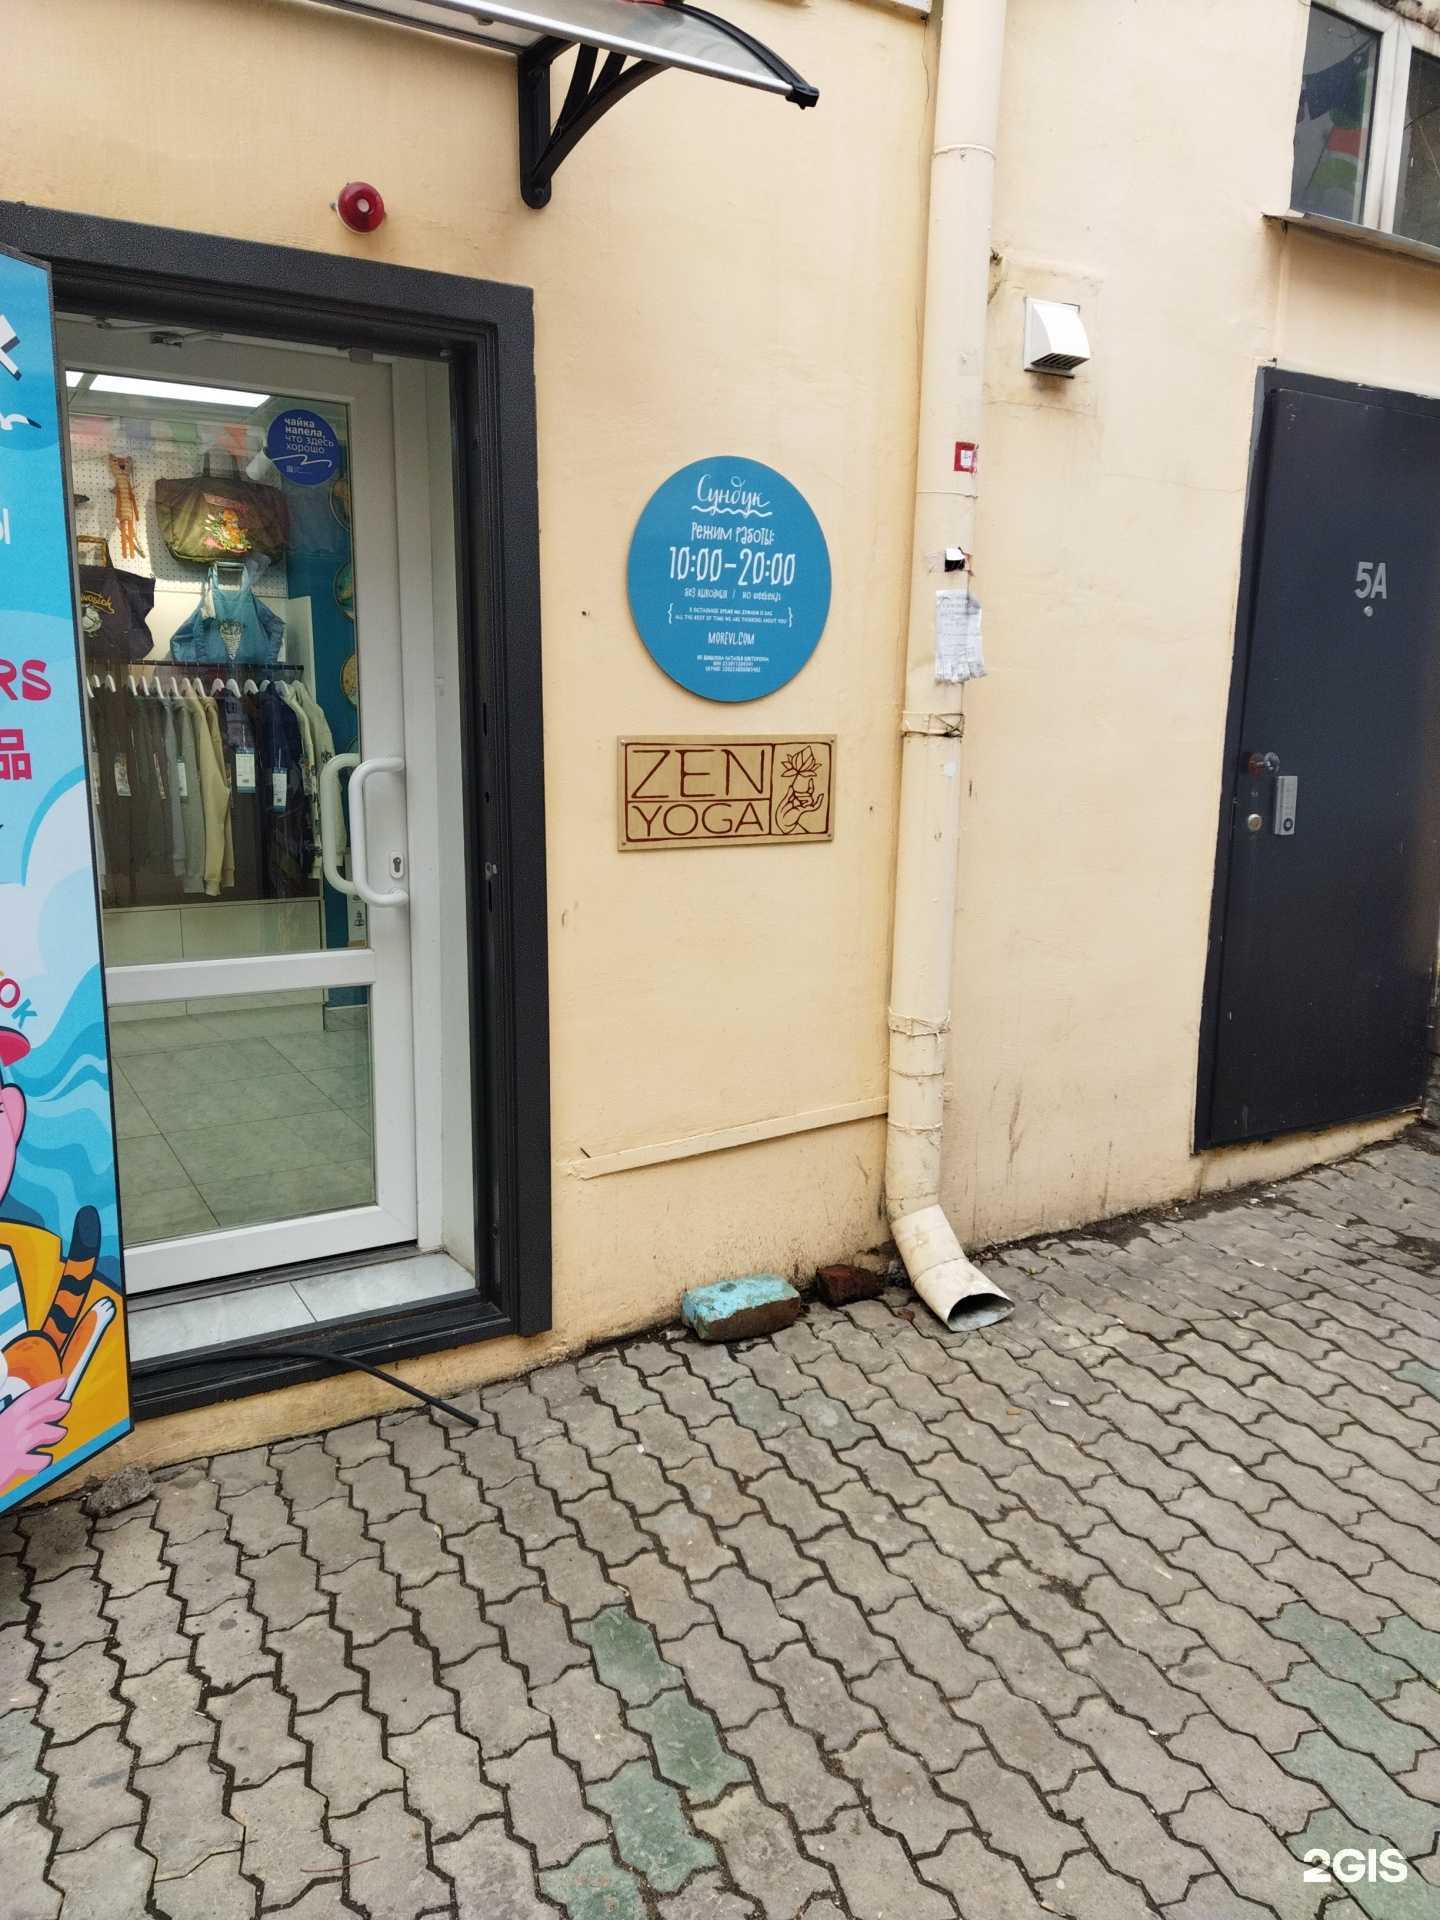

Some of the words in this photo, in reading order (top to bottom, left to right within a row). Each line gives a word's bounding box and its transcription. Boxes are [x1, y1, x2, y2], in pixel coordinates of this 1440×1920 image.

[285, 416, 315, 428] чайка
[285, 435, 303, 443] что
[305, 437, 334, 447] здесь
[697, 474, 770, 518] Сундук
[1354, 561, 1387, 599] 5A
[632, 749, 765, 798] ZEN
[632, 802, 763, 836] YOGA
